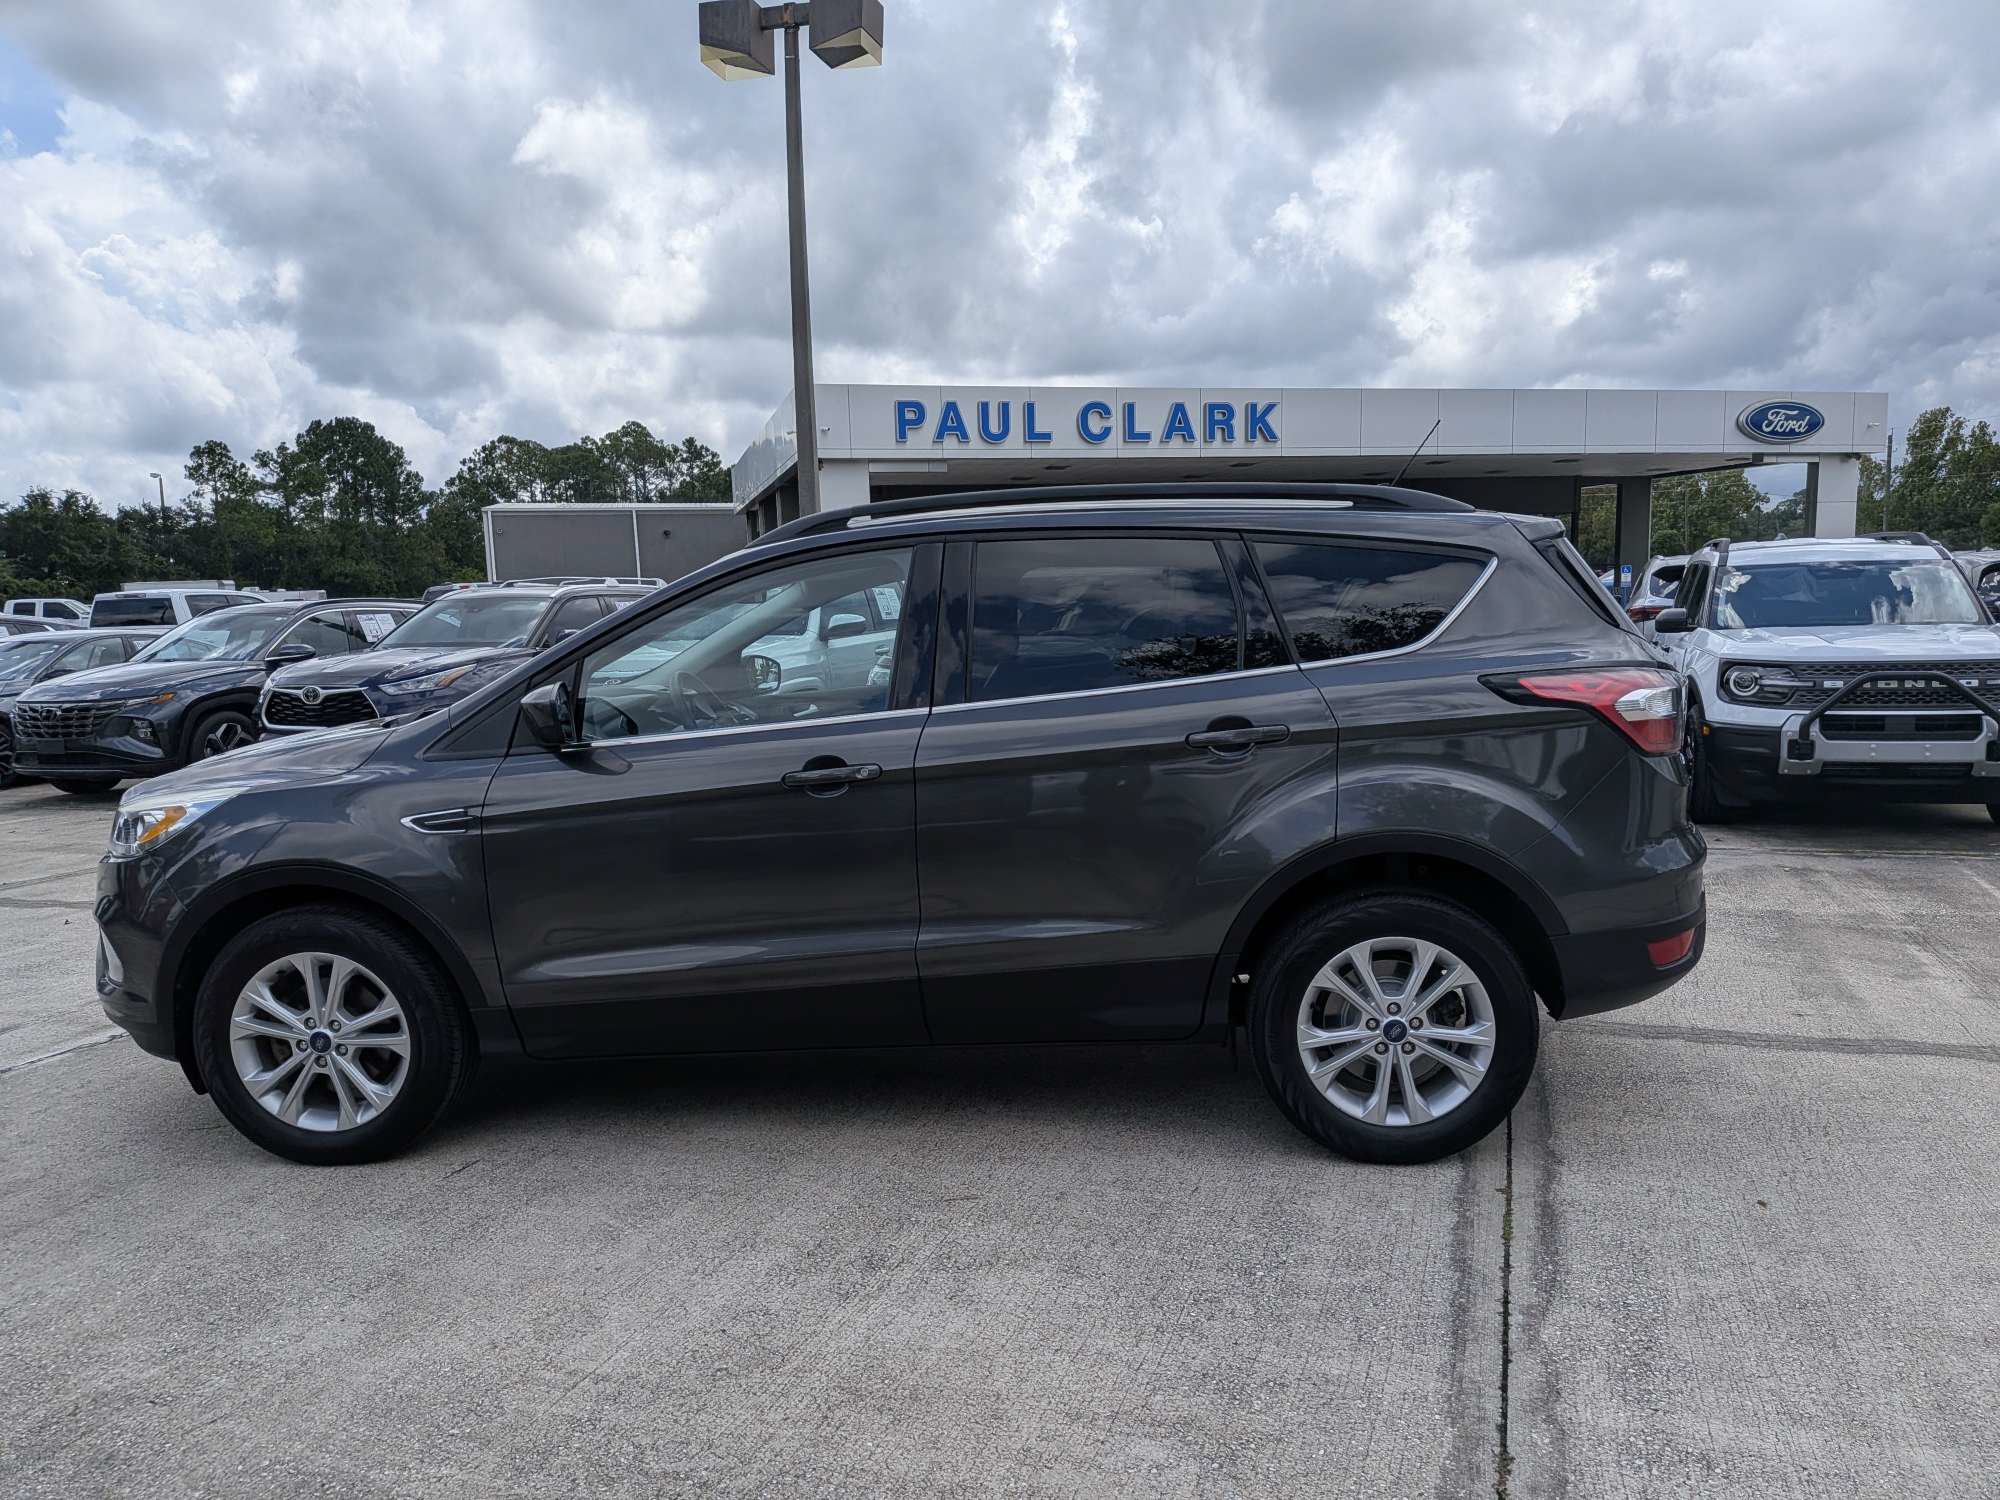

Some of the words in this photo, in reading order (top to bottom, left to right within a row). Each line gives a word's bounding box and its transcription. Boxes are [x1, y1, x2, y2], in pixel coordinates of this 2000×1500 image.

[895, 400, 1053, 443] PAUL
[1077, 400, 1280, 443] CLARK
[1762, 409, 1810, 433] Ford
